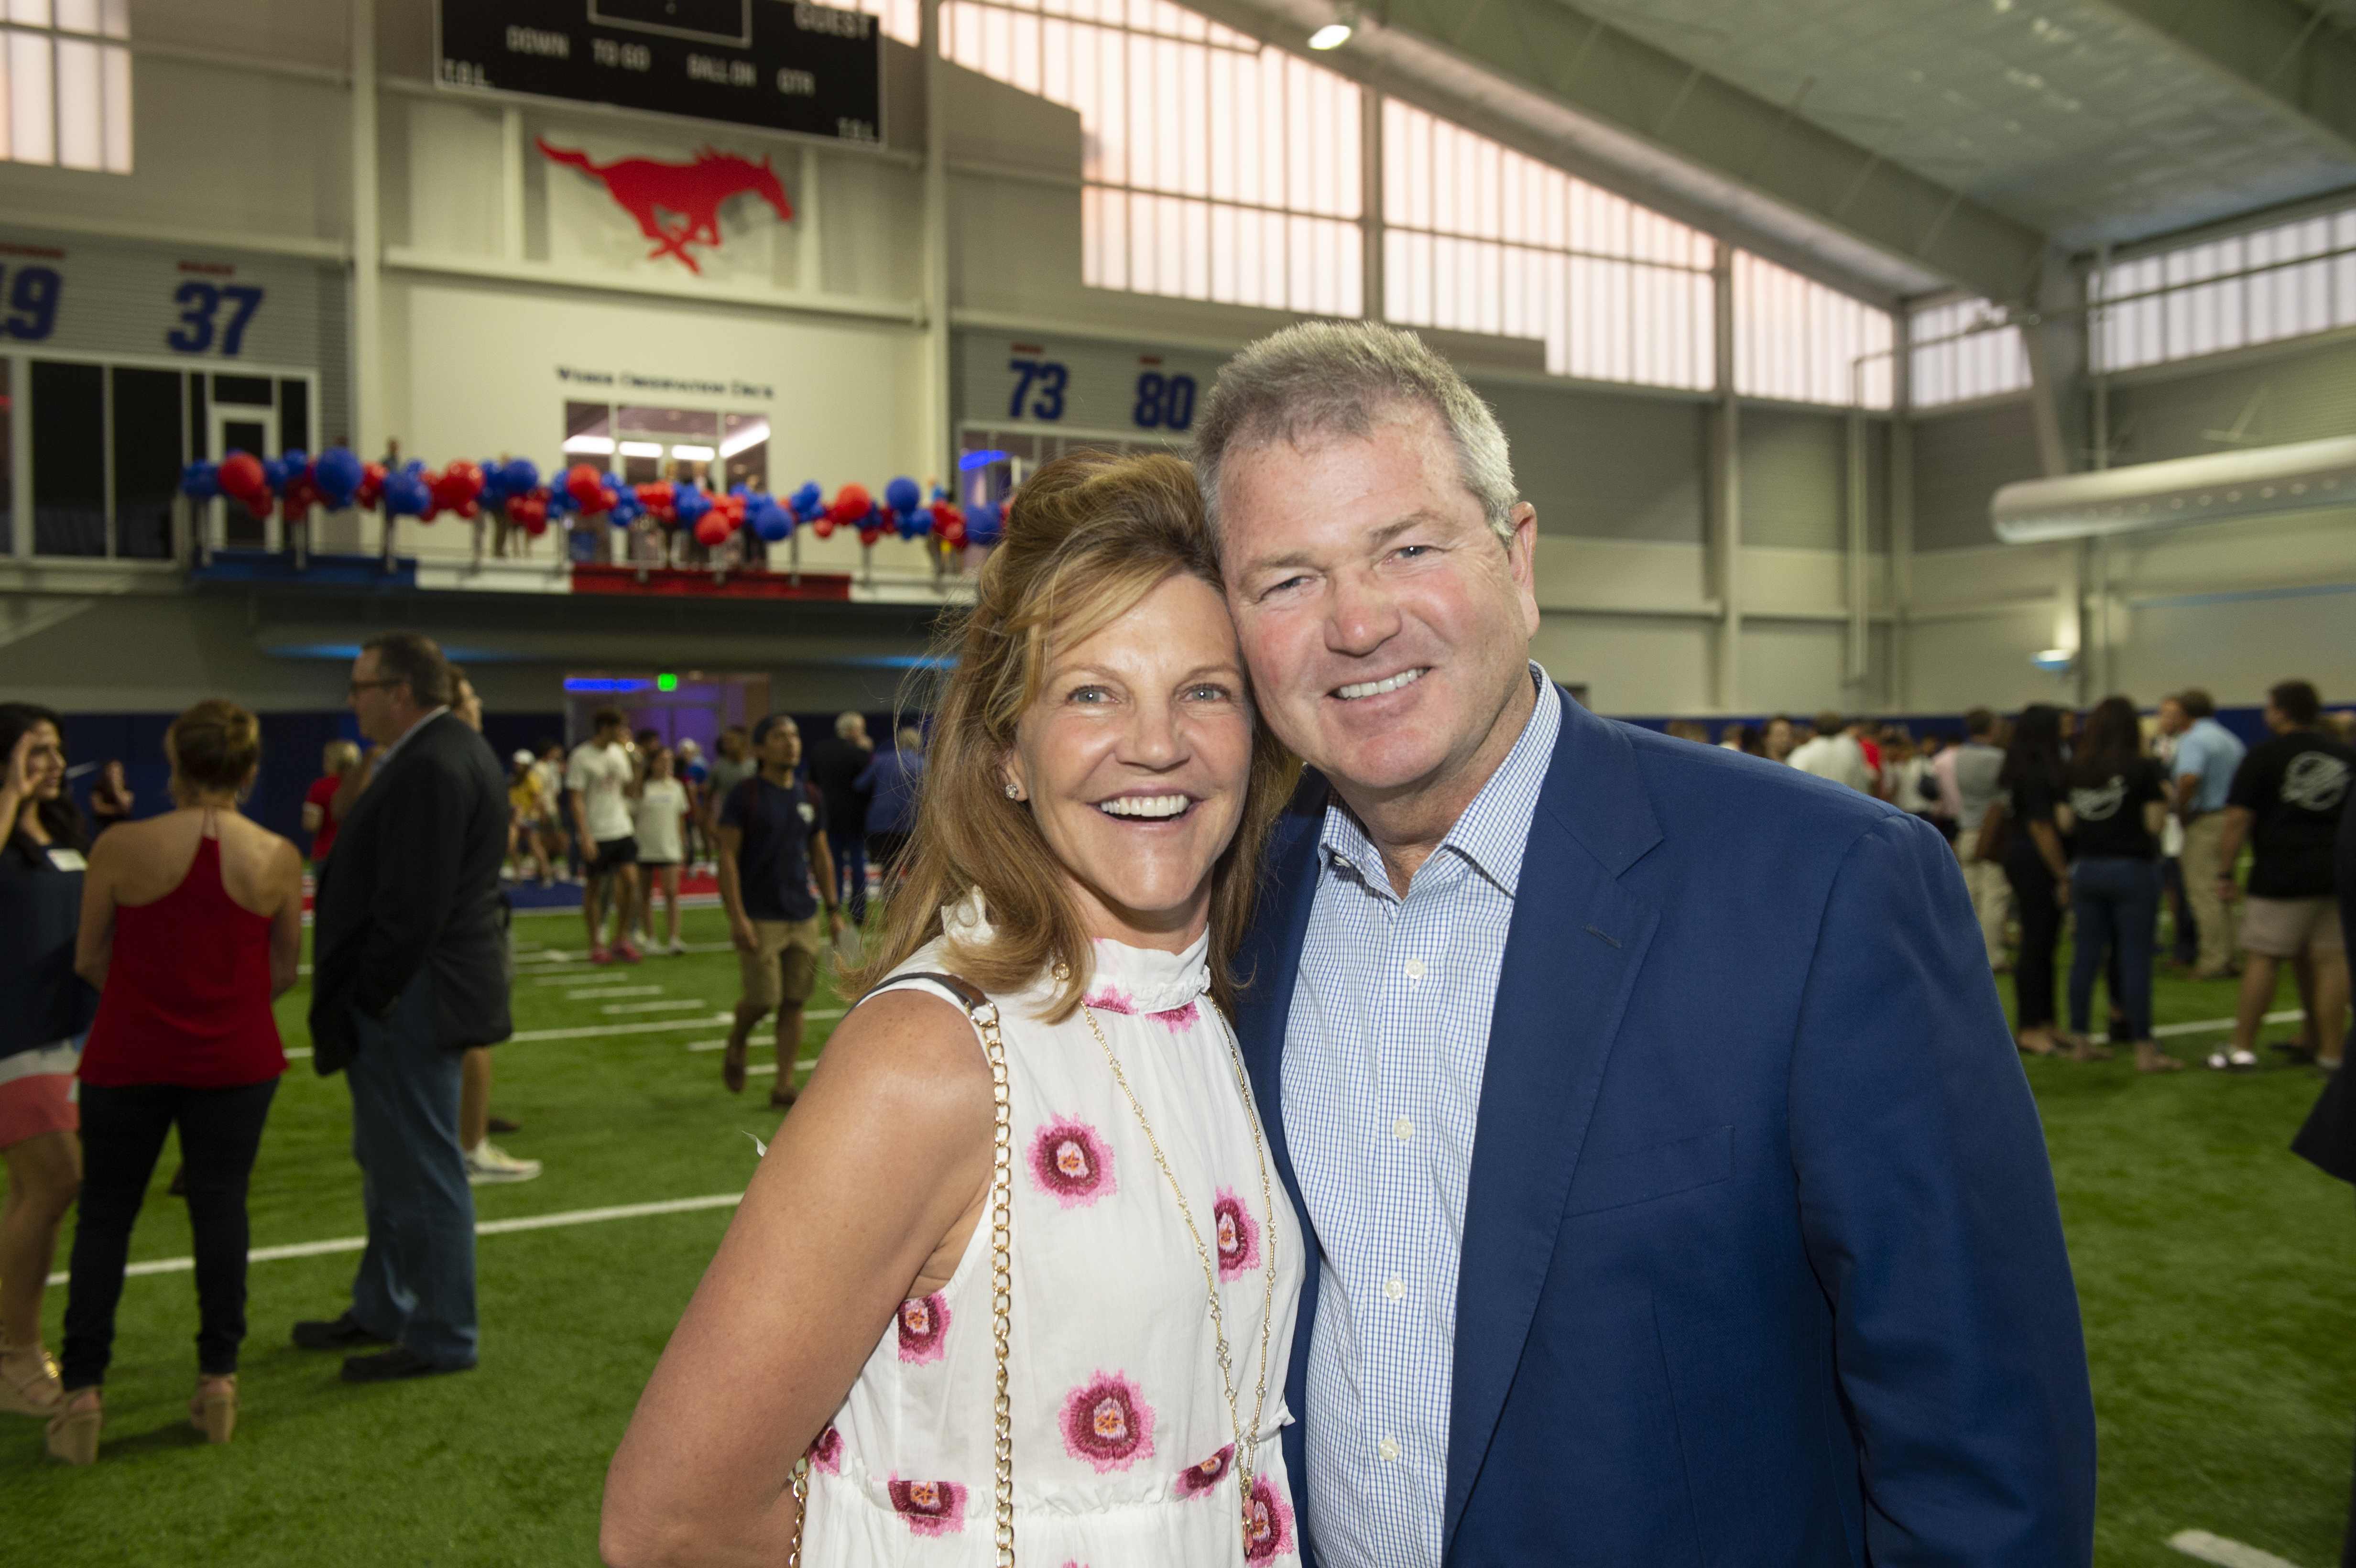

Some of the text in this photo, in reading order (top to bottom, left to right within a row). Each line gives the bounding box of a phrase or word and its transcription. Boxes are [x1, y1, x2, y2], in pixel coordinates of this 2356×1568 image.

[794, 1, 871, 39] GUEST
[505, 25, 569, 58] DOWN
[592, 38, 650, 71] TO GO
[687, 53, 757, 87] BALL ON
[776, 68, 816, 96] QTR
[0, 264, 62, 340] 9
[167, 280, 264, 357] 37
[1009, 359, 1068, 422] 73
[1134, 371, 1196, 431] 80
